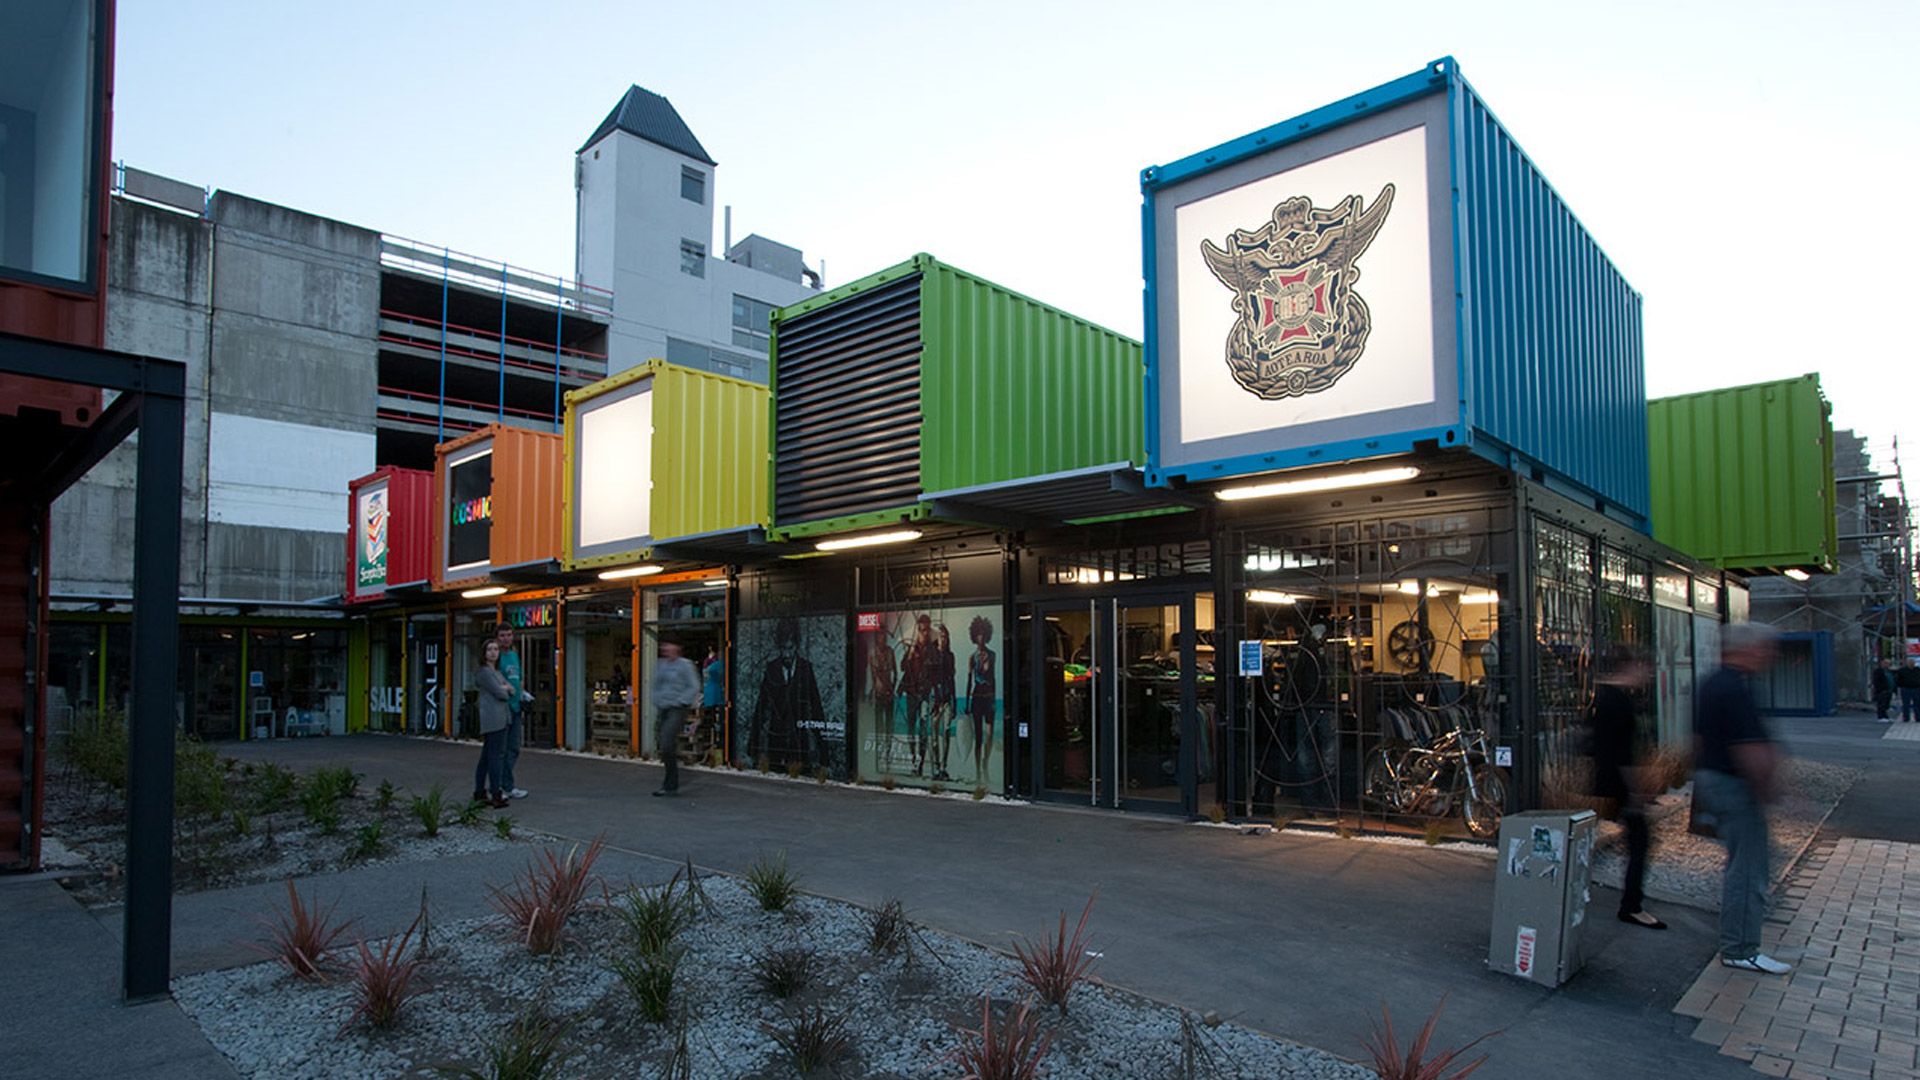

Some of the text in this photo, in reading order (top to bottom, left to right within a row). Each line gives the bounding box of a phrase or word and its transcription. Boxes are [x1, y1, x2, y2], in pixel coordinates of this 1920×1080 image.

[1264, 352, 1328, 377] AOTEAROA
[453, 496, 492, 526] COSMIC
[511, 604, 553, 628] COSMIC
[370, 686, 402, 713] SALE
[425, 642, 438, 730] SALE
